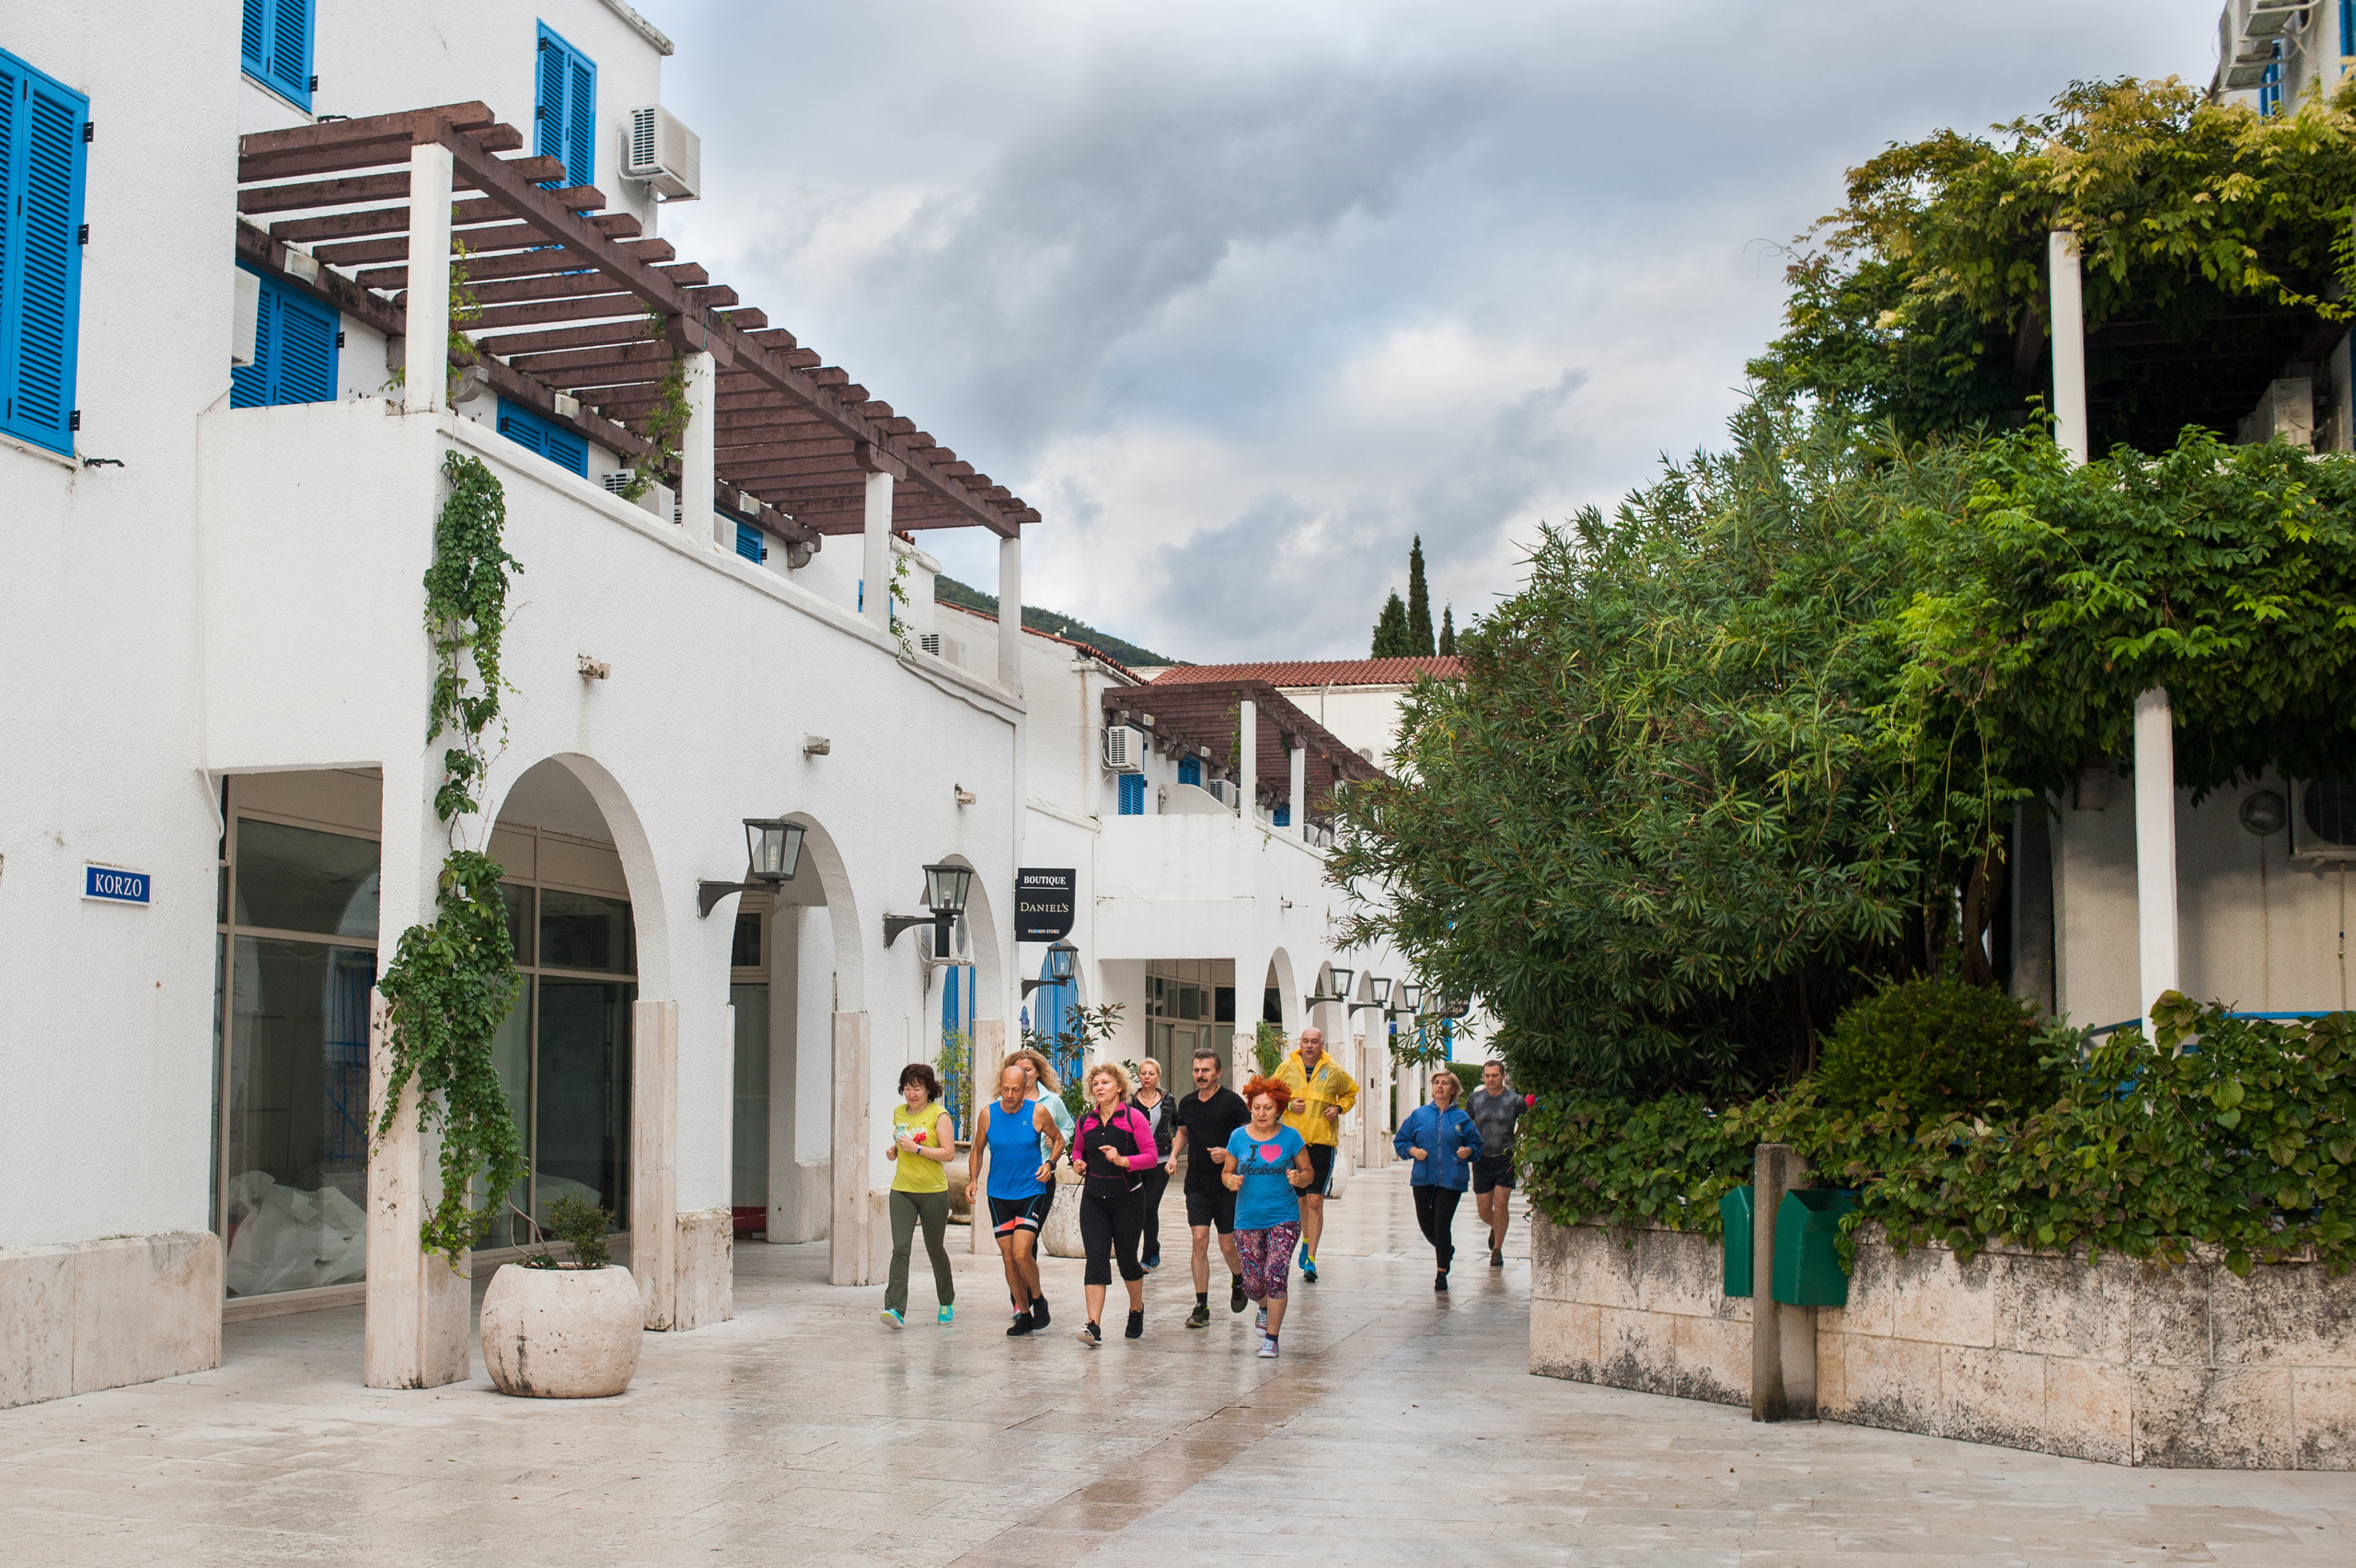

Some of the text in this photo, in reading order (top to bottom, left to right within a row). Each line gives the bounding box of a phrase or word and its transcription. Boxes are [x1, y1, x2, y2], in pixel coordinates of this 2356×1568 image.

[95, 873, 142, 897] KORZO
[1023, 876, 1067, 886] BOUTIQUE
[1247, 1144, 1258, 1162] I
